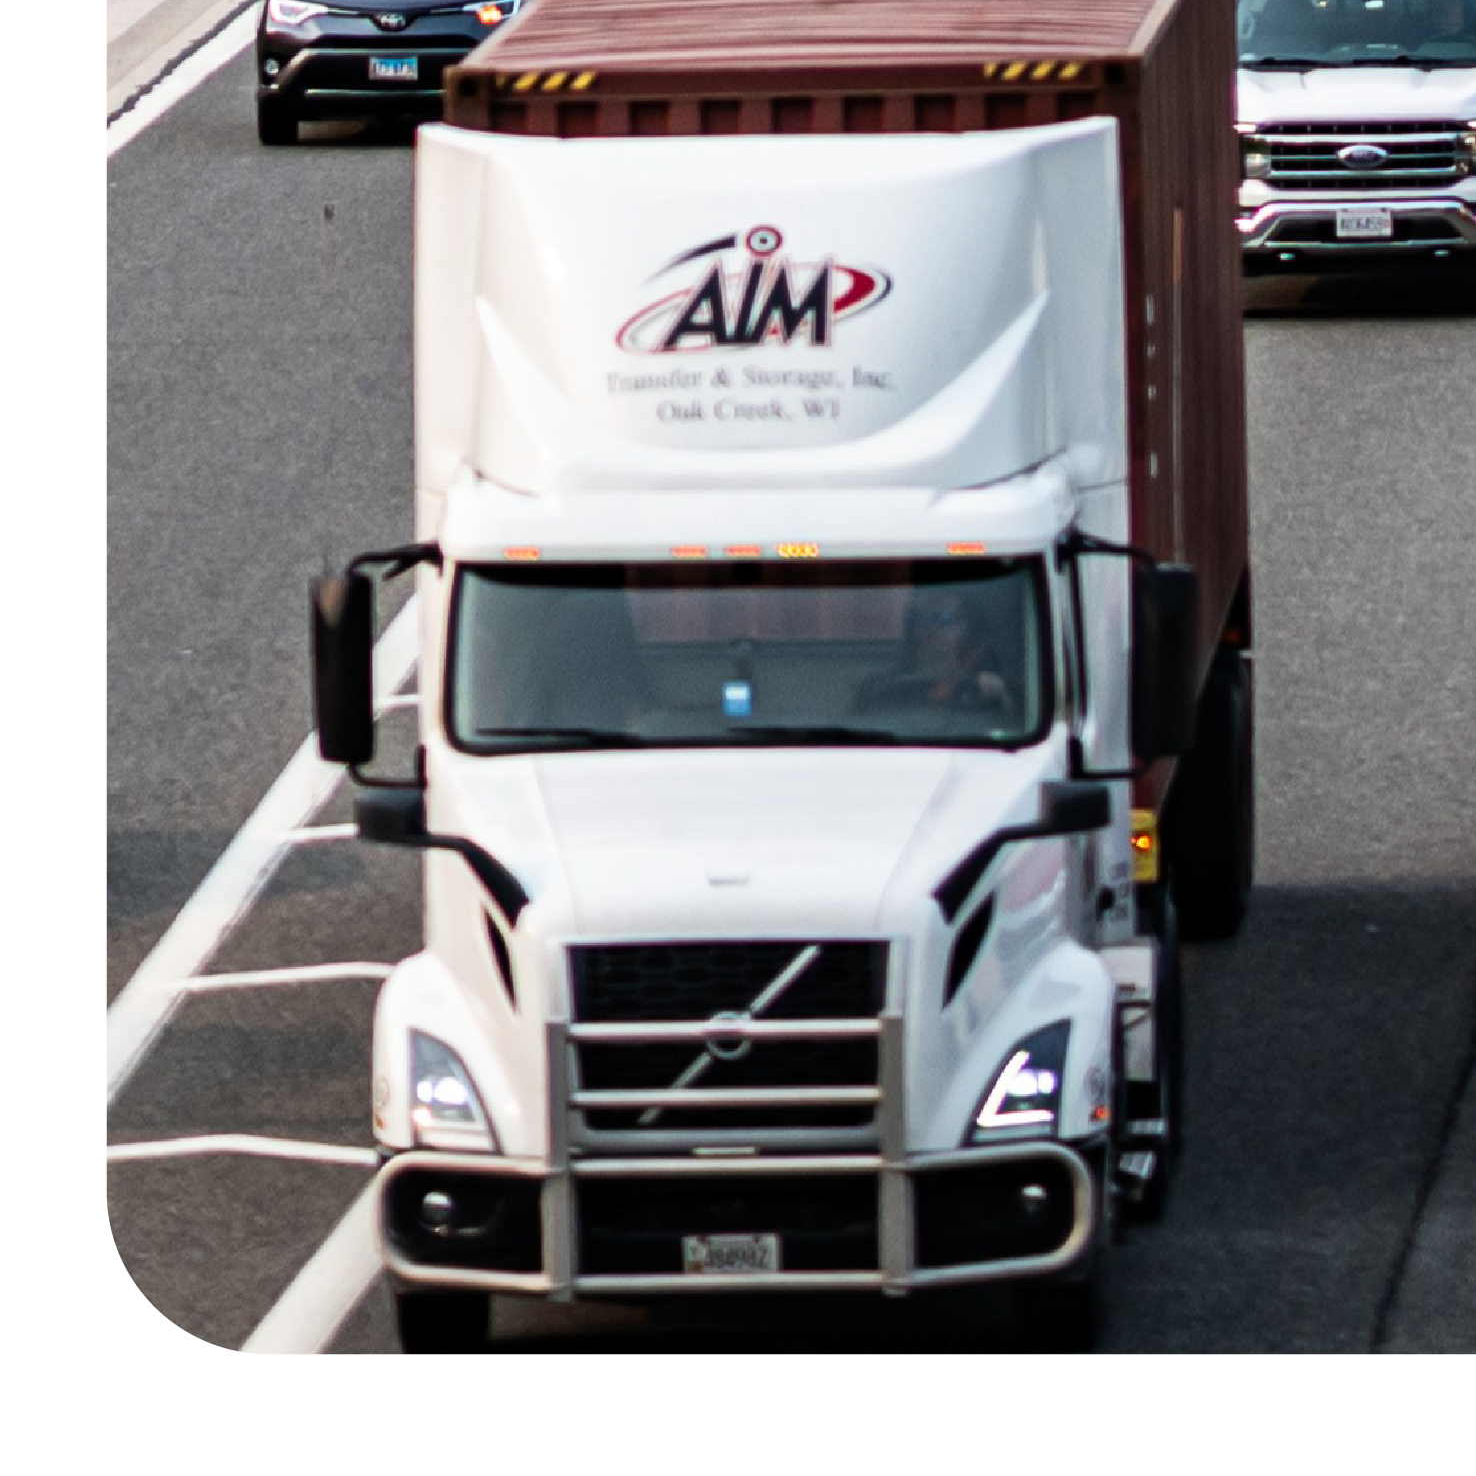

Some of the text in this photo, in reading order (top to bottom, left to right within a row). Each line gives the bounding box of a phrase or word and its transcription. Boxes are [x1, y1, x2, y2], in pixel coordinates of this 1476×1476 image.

[657, 226, 834, 352] AIM
[607, 365, 703, 395] Transfer
[711, 366, 732, 389] &
[656, 399, 705, 422] Oak
[803, 396, 841, 422] WI
